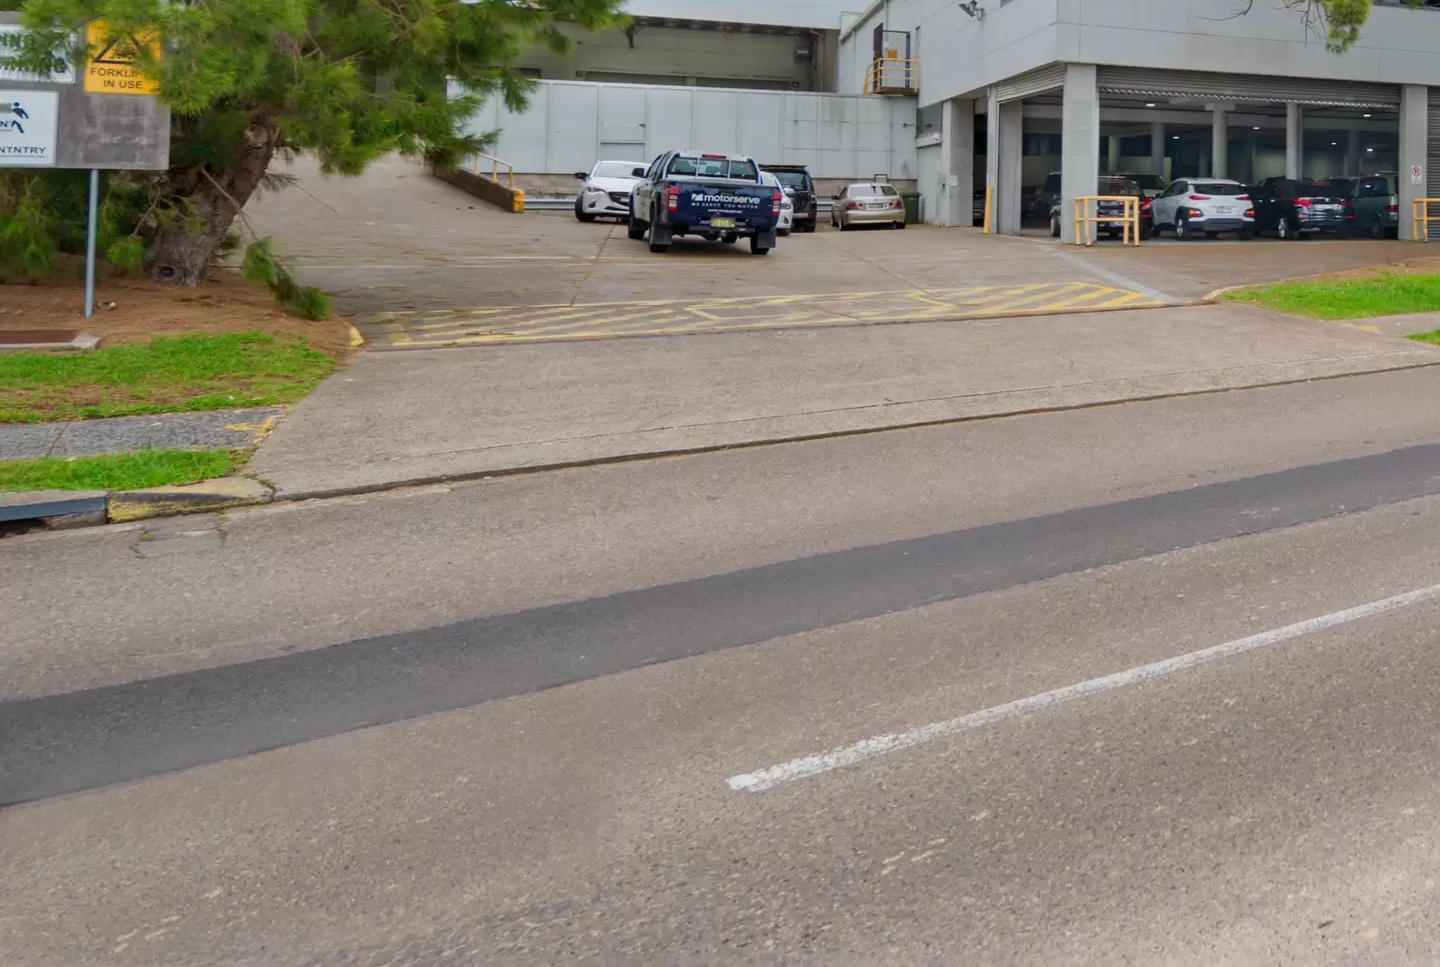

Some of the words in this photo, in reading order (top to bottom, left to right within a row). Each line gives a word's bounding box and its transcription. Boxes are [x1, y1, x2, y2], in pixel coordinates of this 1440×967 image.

[90, 67, 142, 78] FORKLIF
[103, 79, 115, 87] IN
[119, 80, 143, 89] USE
[704, 194, 760, 204] motorserve
